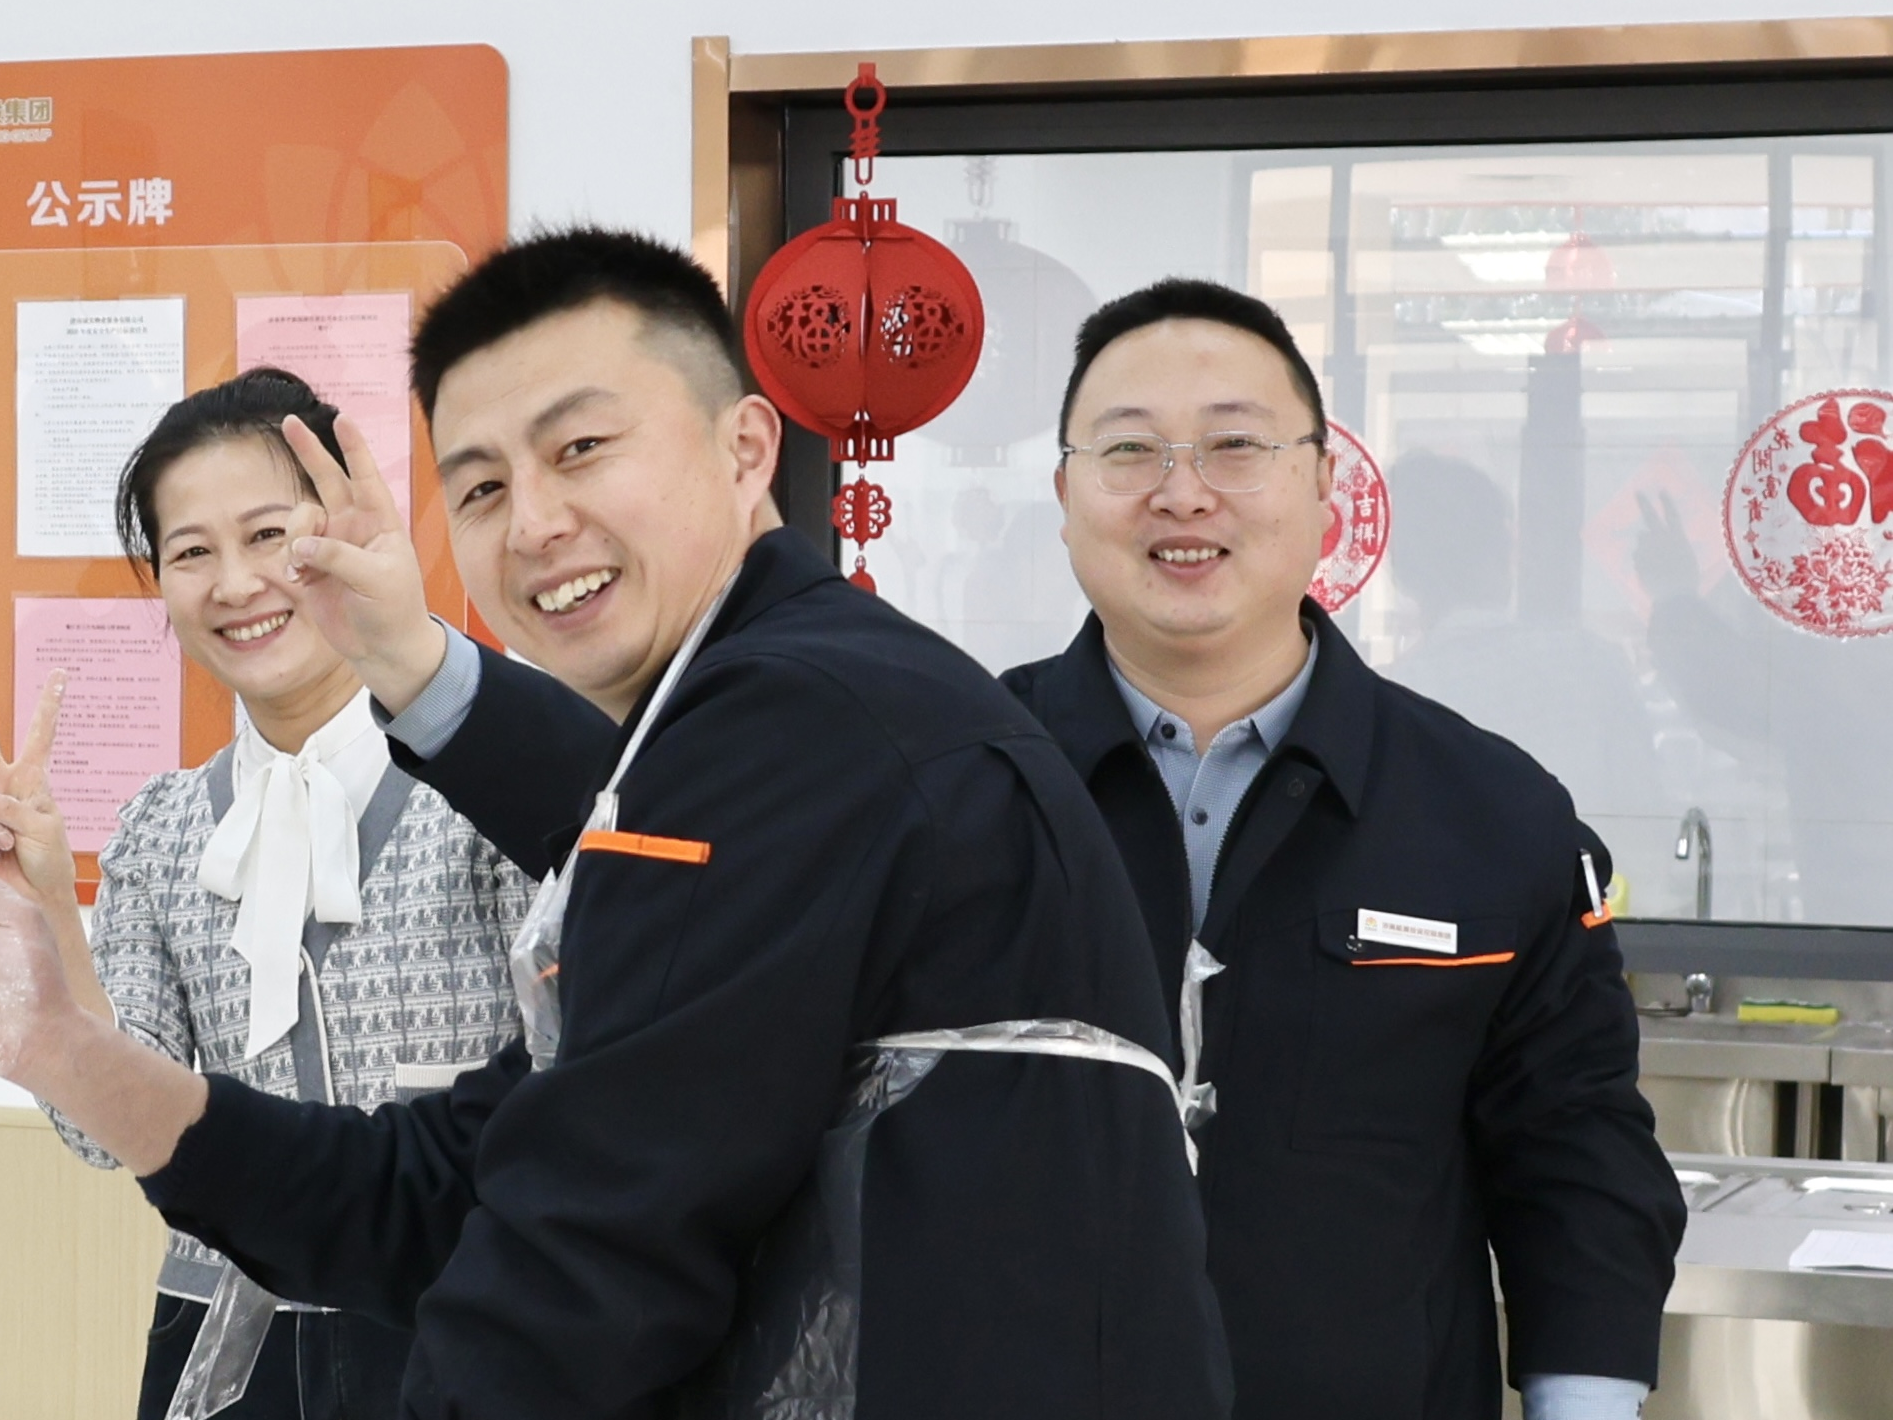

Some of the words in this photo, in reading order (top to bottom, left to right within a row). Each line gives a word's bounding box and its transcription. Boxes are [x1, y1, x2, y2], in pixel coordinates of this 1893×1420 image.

[26, 177, 174, 227] 公示牌
[1354, 492, 1377, 546] 吉祥
